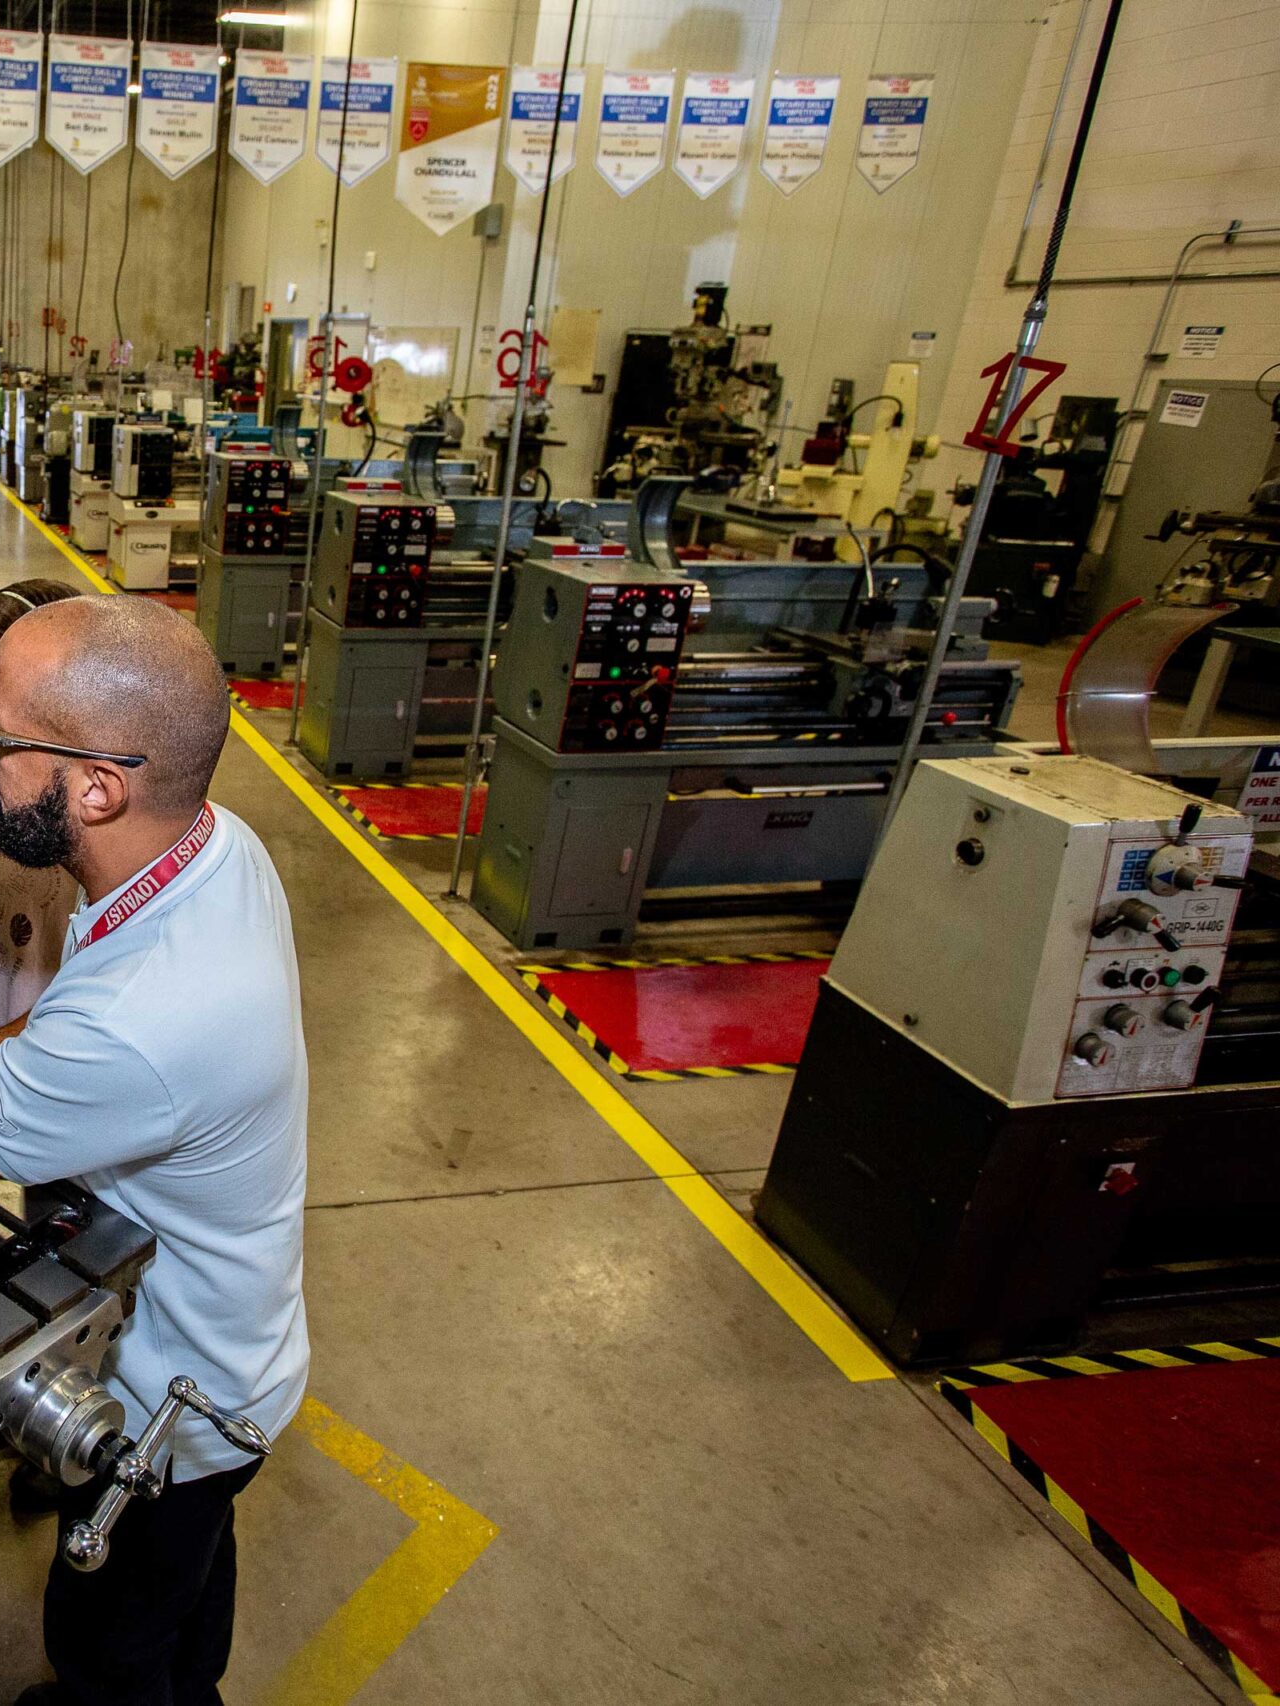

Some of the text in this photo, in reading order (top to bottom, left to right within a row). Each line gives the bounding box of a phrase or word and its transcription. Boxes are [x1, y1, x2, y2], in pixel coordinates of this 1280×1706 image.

[4, 61, 34, 72] SKILLS
[55, 65, 122, 79] ONTARIO SKILLS
[60, 74, 116, 86] COMPETITION
[146, 72, 212, 85] ONTARIO SKILLS
[72, 84, 104, 93] WINNER
[151, 80, 206, 92] COMPETITION
[241, 78, 306, 92] ONTARIO SKILLS
[162, 90, 194, 100] WINNER
[246, 88, 301, 99] COMPETITION
[256, 96, 289, 106] WINNER
[774, 100, 831, 110] ONTARIO SKILLS
[778, 109, 826, 117] COMPETITION
[426, 157, 467, 167] SPENCER
[966, 352, 1067, 446] 17
[1250, 776, 1279, 788] ONE
[1245, 796, 1270, 806] PER
[1166, 920, 1224, 934] GRIP-1440G
